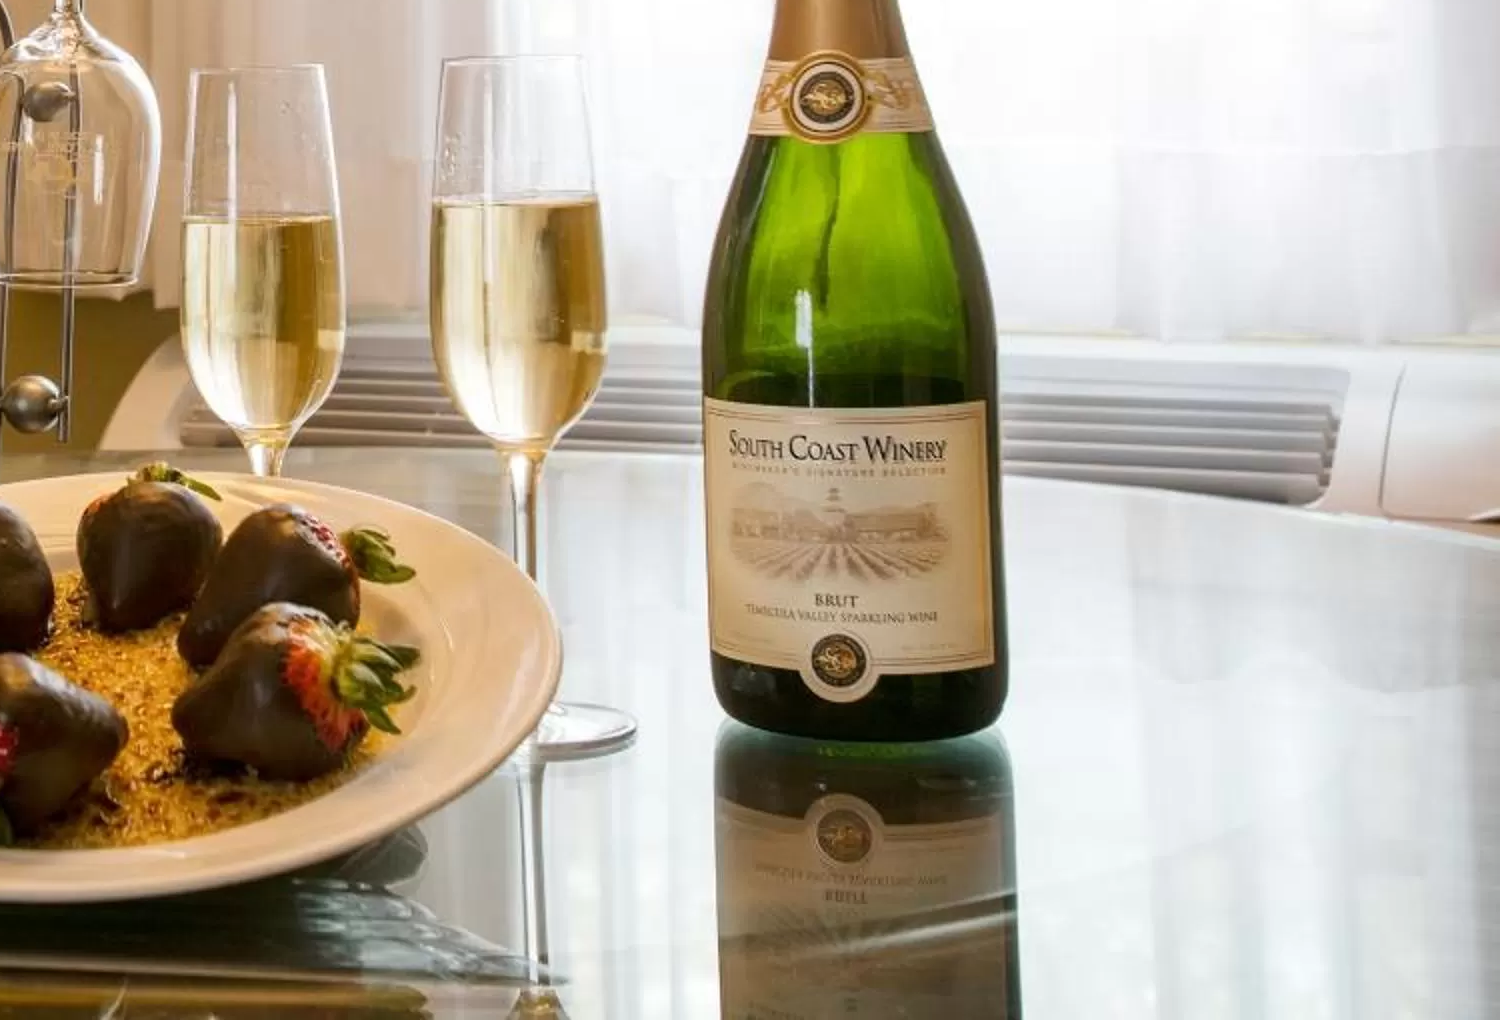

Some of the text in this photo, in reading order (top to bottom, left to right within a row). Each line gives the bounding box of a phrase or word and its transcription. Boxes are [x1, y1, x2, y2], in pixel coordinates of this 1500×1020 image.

[729, 429, 948, 463] SOUTH COAST WINERY
[814, 593, 859, 609] BRUT
